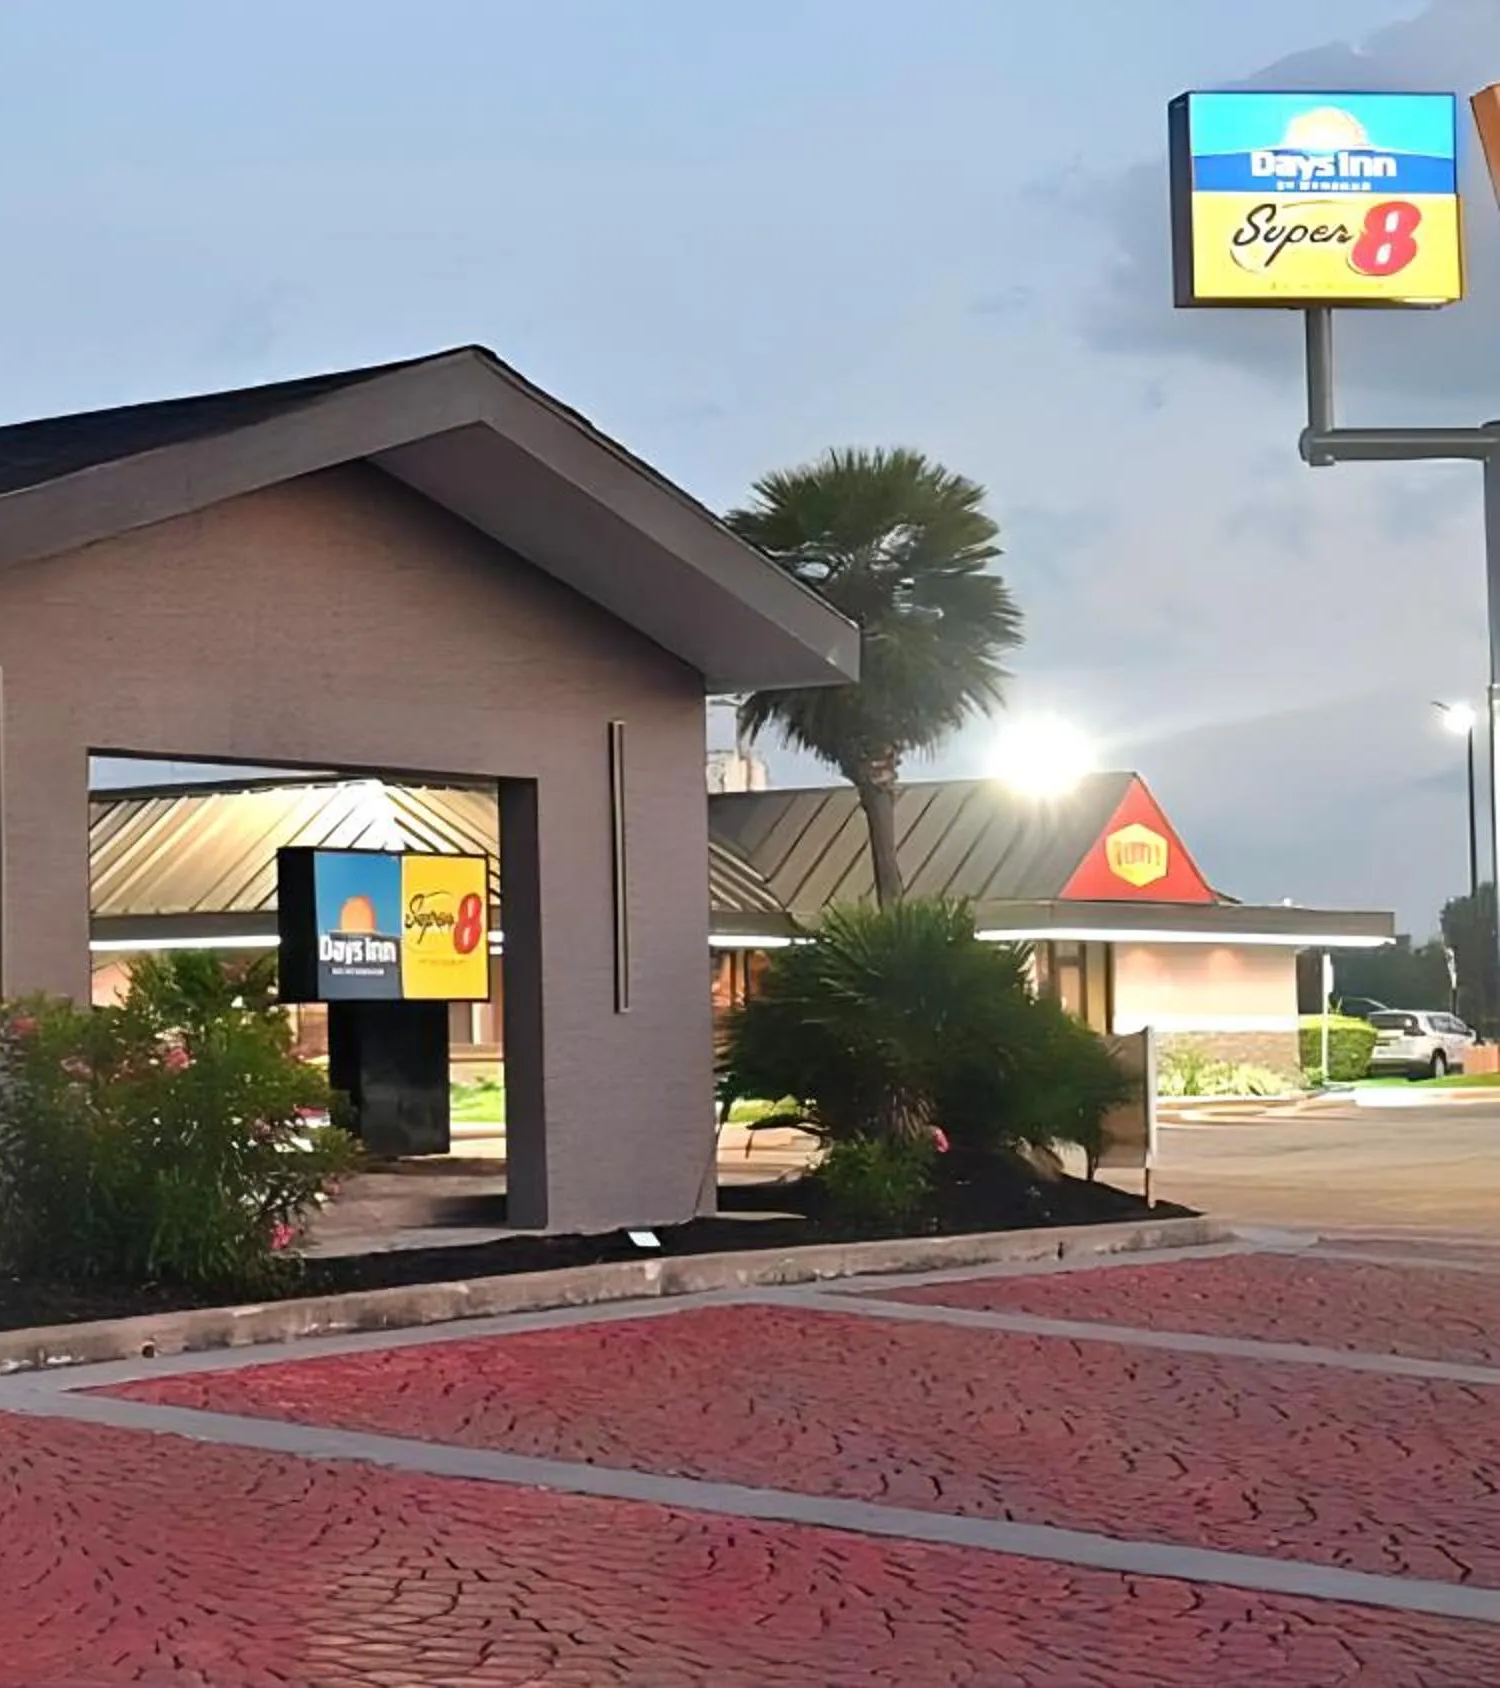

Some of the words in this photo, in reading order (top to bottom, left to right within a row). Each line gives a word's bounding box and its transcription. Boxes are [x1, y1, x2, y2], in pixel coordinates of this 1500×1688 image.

[1251, 151, 1335, 180] Days
[1337, 151, 1397, 177] Inn
[1232, 203, 1353, 267] Super
[1350, 200, 1422, 277] 8
[453, 892, 482, 955] 8
[319, 935, 363, 965] Days
[364, 936, 397, 963] Inn
